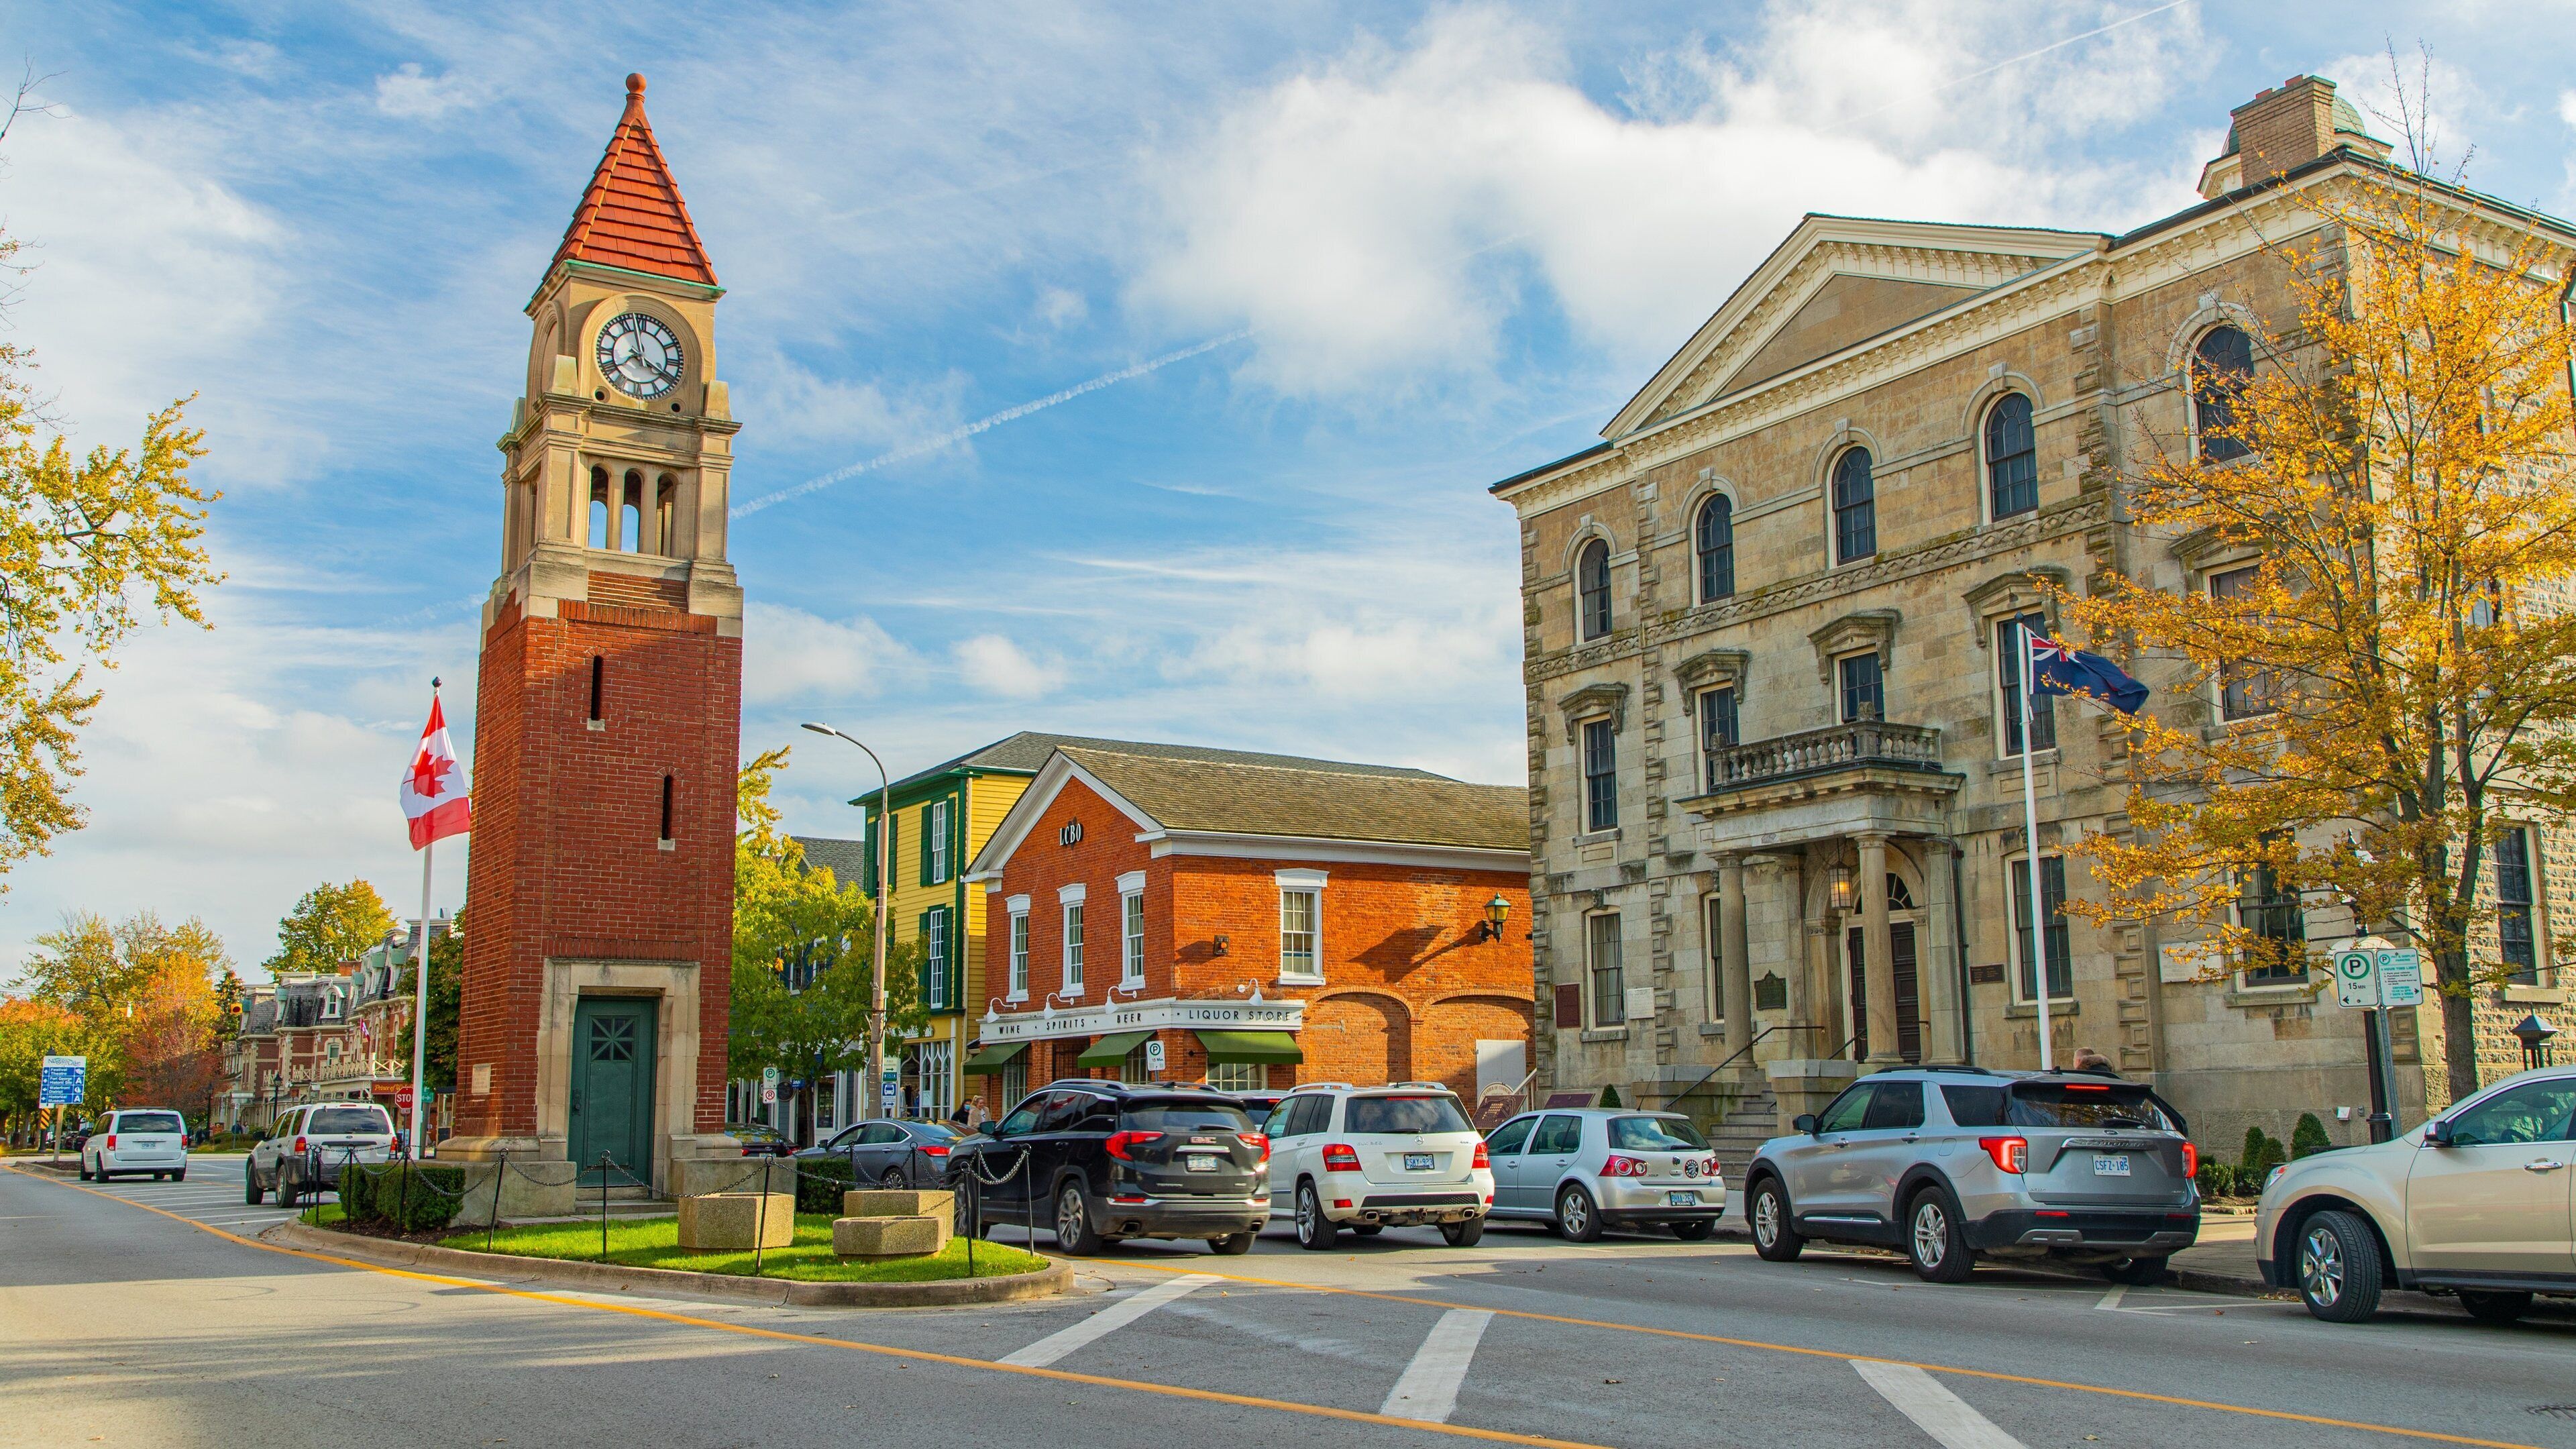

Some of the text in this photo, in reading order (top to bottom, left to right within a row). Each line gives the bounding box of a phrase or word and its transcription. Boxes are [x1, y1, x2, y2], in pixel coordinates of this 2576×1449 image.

[1059, 823, 1081, 846] LCBO
[2349, 959, 2361, 973] P
[1117, 1013, 1141, 1024] BEER
[1189, 1010, 1291, 1021] LIQUOR STORE
[999, 1025, 1020, 1034] WINE
[1046, 1018, 1085, 1030] SPIRITS
[396, 1093, 412, 1102] STO
